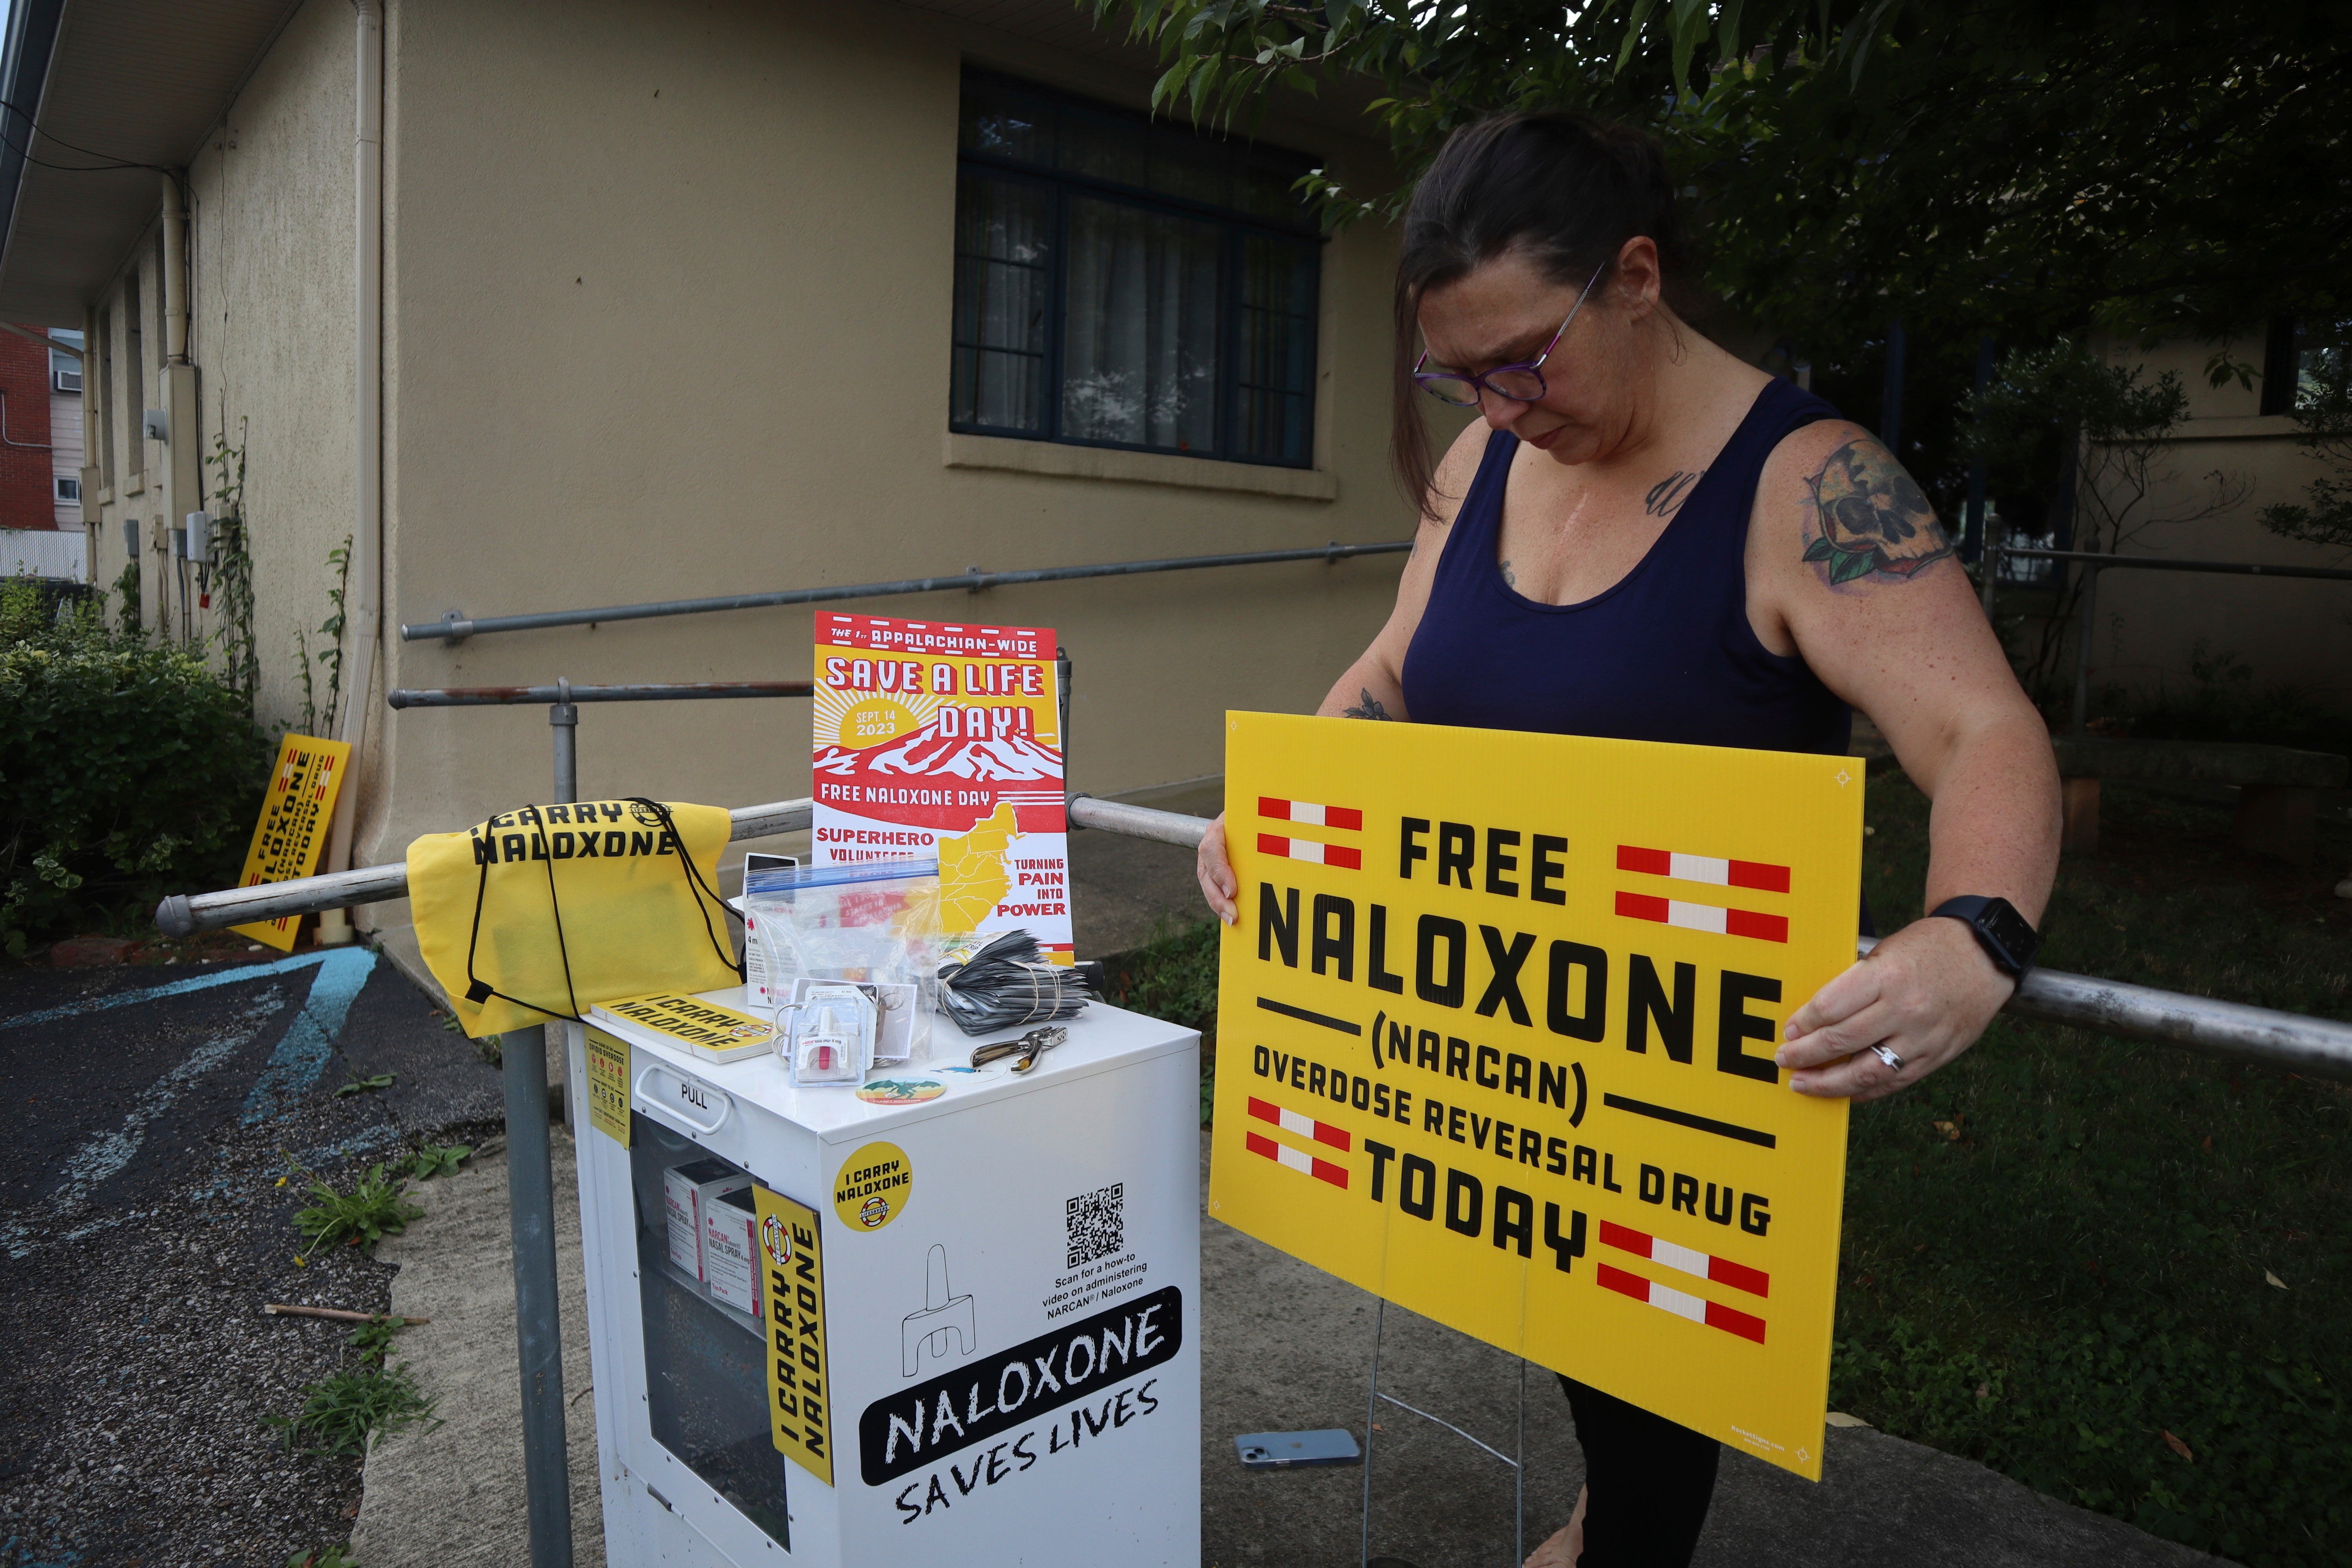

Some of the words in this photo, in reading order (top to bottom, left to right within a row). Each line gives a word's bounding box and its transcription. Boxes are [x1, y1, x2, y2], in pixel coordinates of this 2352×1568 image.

[831, 627, 852, 638] THE
[871, 630, 1037, 652] APPALACHIAN-WIDE
[826, 657, 924, 695] SAVE
[932, 663, 957, 695] A
[966, 664, 1044, 696] LIFE
[856, 711, 880, 723] SEPT.
[882, 710, 895, 720] 14
[856, 723, 895, 736] 2023
[938, 706, 1034, 741] DAY!
[291, 793, 313, 855] REVERSAL
[311, 755, 325, 788] DRUG
[821, 783, 860, 802] FREE
[866, 786, 953, 805] NALOXONE
[959, 790, 990, 806] DAY
[260, 751, 310, 885] LOXONE
[492, 803, 622, 828] CARRY
[258, 804, 280, 860] FREE
[277, 800, 304, 874] (NARCAN)
[292, 804, 319, 879] TODAY
[816, 828, 934, 846] SUPERHERO
[472, 831, 675, 865] NALOXONE
[1400, 815, 1569, 906] FREE
[1015, 858, 1064, 870] TURNING
[1019, 873, 1064, 886] PAIN
[1037, 888, 1063, 900] INTO
[997, 903, 1066, 916] POWER
[1257, 882, 1783, 1084] NALOXONE
[609, 1002, 740, 1047] NALOXONE
[656, 999, 745, 1027] CARRY
[589, 1043, 602, 1055] OPIOID
[603, 1049, 624, 1065] OVERDOSE
[1372, 1010, 1588, 1129] (NARCAN)
[681, 1083, 707, 1110] PULL
[1253, 1045, 1412, 1126] OVERDOSE
[1423, 1099, 1624, 1194] REVERSAL
[1639, 1163, 1771, 1238] DRUG
[846, 1174, 849, 1185] I
[854, 1160, 899, 1183] CARRY
[837, 1172, 909, 1203] NALOXONE
[677, 1212, 688, 1227] SPRAY
[861, 1206, 888, 1217] LIFESAVERS
[1364, 1138, 1588, 1274] TODAY
[709, 1238, 724, 1253] NASAL
[725, 1245, 741, 1259] SPRAY
[1043, 1292, 1068, 1307] video
[1071, 1287, 1083, 1296] on
[1086, 1263, 1147, 1291] administering
[1055, 1274, 1078, 1288] Scan
[1082, 1268, 1094, 1279] for
[1105, 1253, 1135, 1270] how-to
[719, 1286, 728, 1296] Pack
[1102, 1278, 1143, 1299] Naloxone
[772, 1269, 799, 1417] CARRY
[792, 1222, 825, 1459] NALOXONE
[885, 1303, 1165, 1464] NALOXONE
[782, 1423, 799, 1442] I
[1731, 1425, 1785, 1451] RocketSigns.com
[895, 1431, 1037, 1524] SAVES
[1049, 1378, 1159, 1454] LIVES
